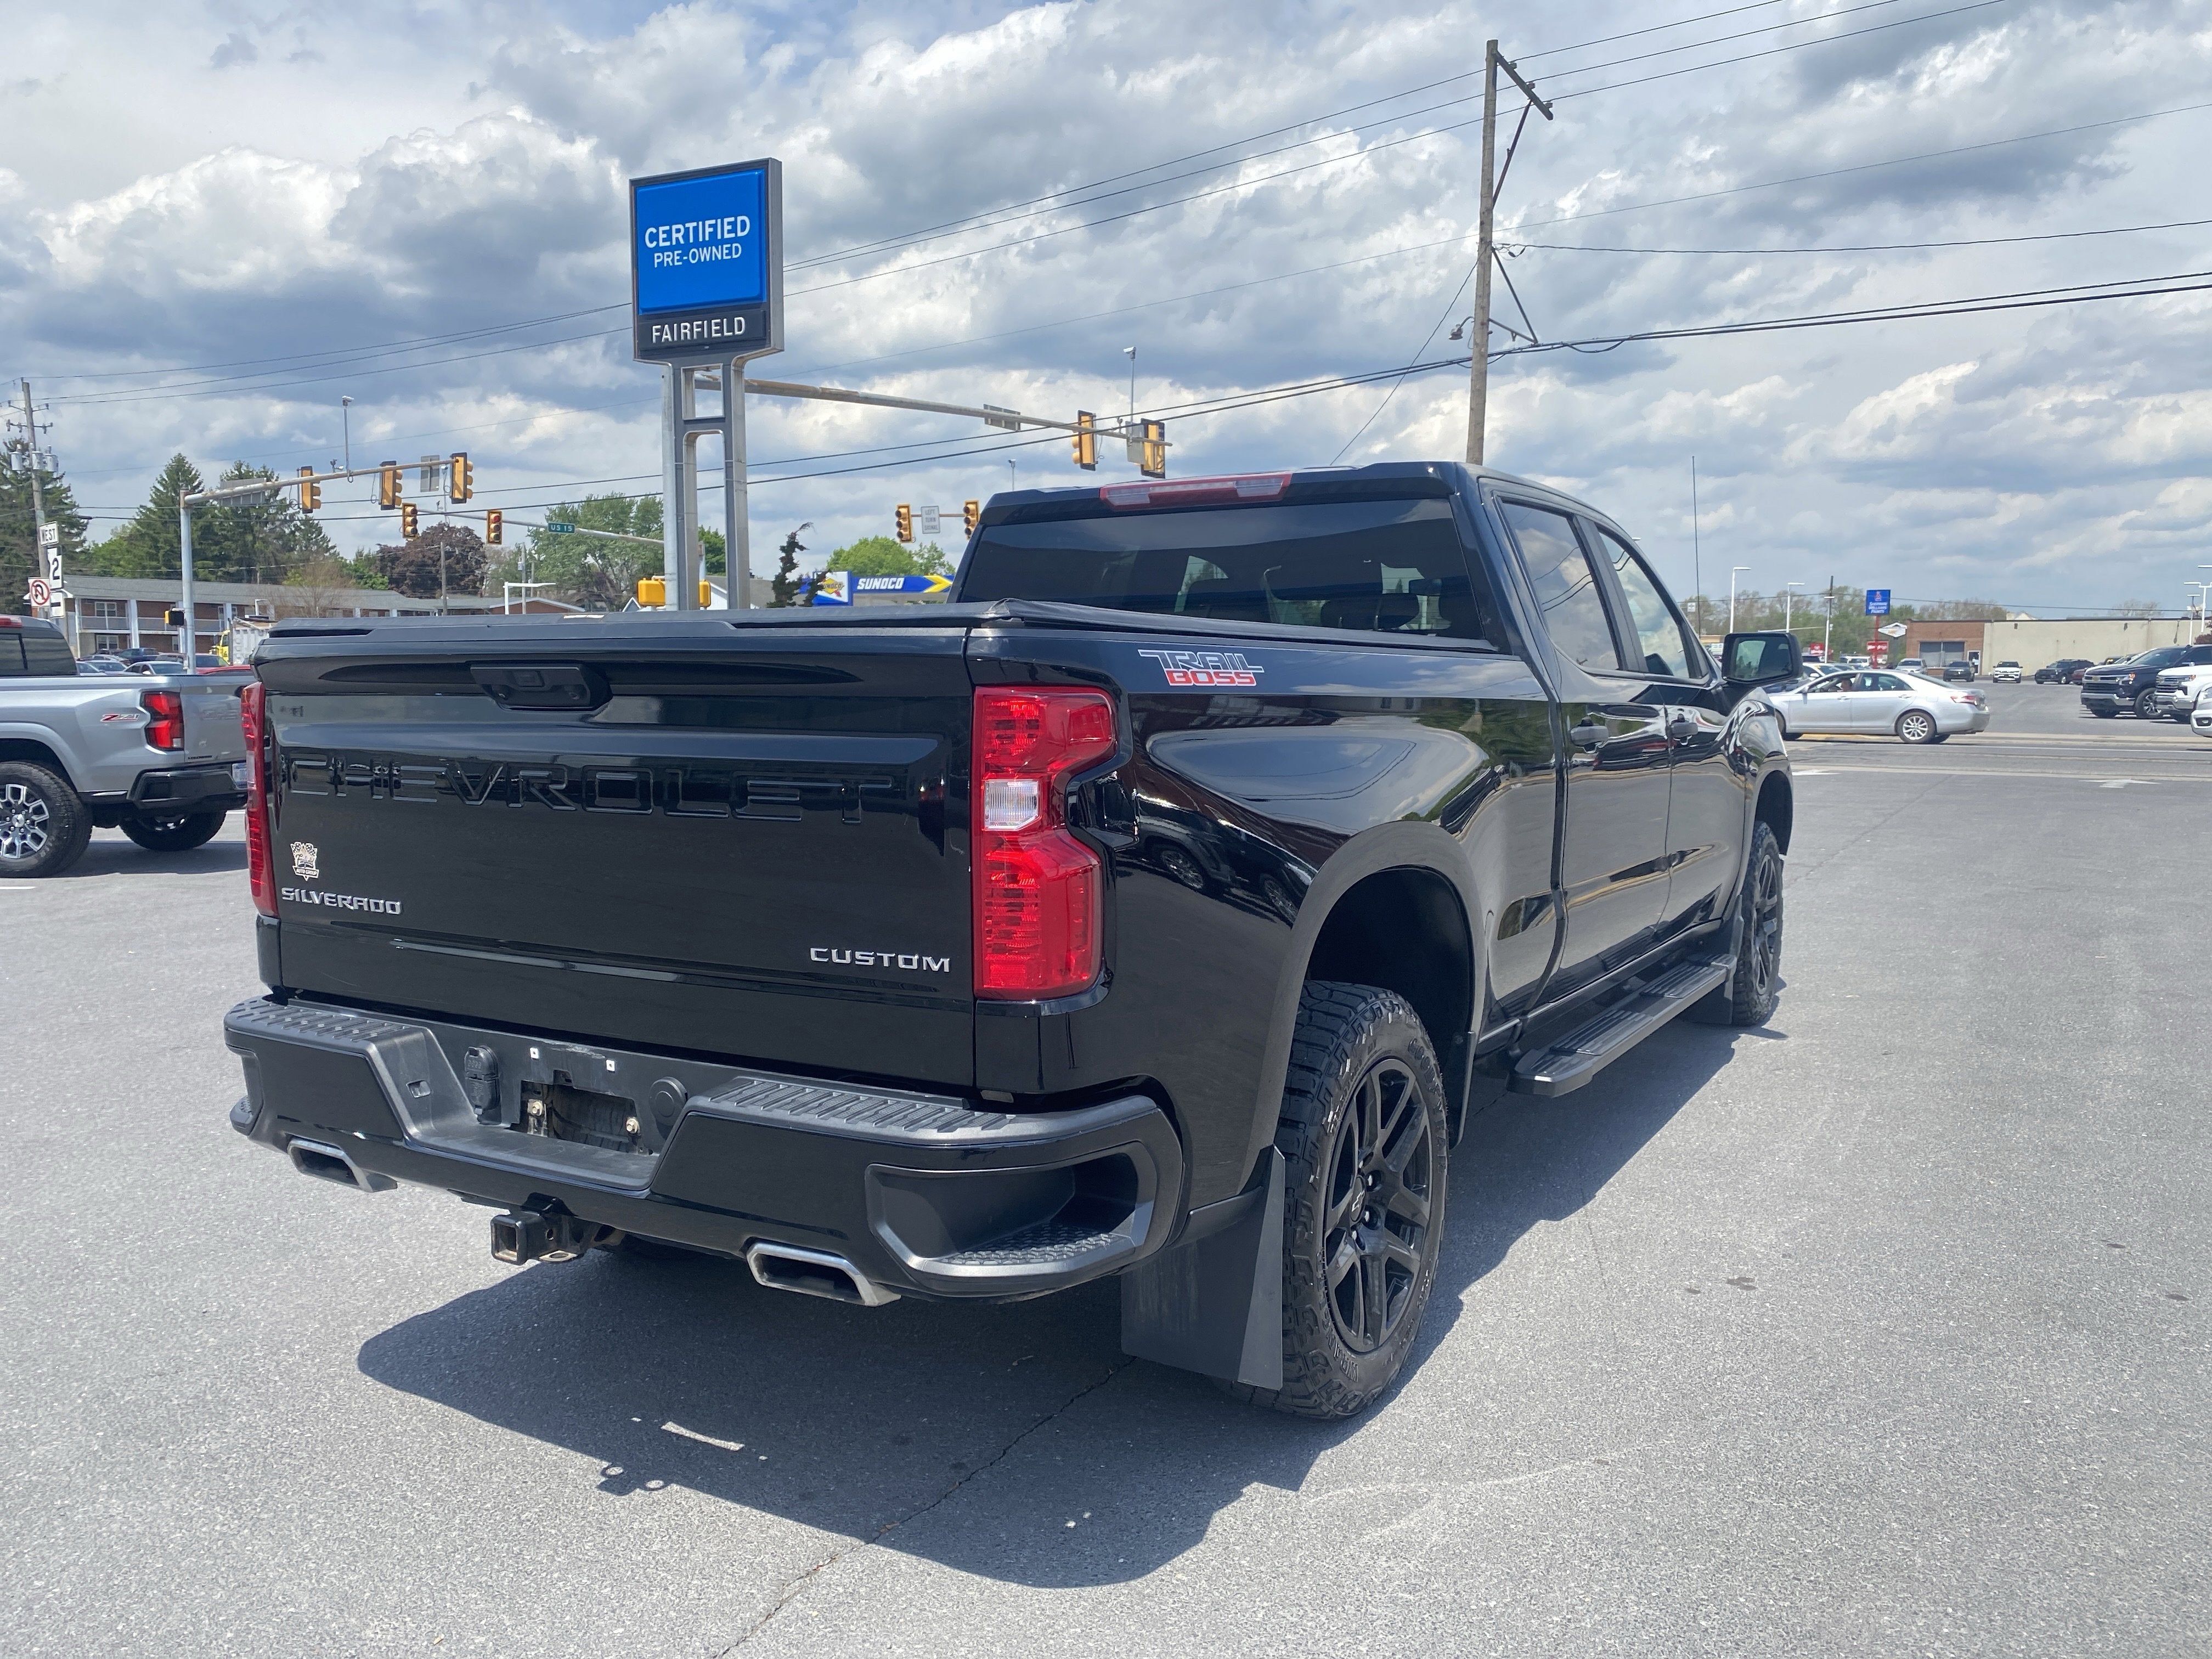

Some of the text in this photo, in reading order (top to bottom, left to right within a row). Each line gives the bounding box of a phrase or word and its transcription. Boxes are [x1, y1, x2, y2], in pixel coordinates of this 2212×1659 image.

[645, 215, 751, 248] CERTIFIED
[654, 243, 742, 268] PRE-OWNED
[652, 317, 746, 343] FAIRFIELD
[857, 578, 905, 590] SUNOCO
[1138, 649, 1265, 673] TRAIL
[1165, 668, 1257, 686] BOSS
[100, 714, 140, 722] Z71
[287, 753, 893, 825] CHEVROLET
[281, 887, 402, 915] SILVERADO
[810, 947, 951, 973] CUSTOM
